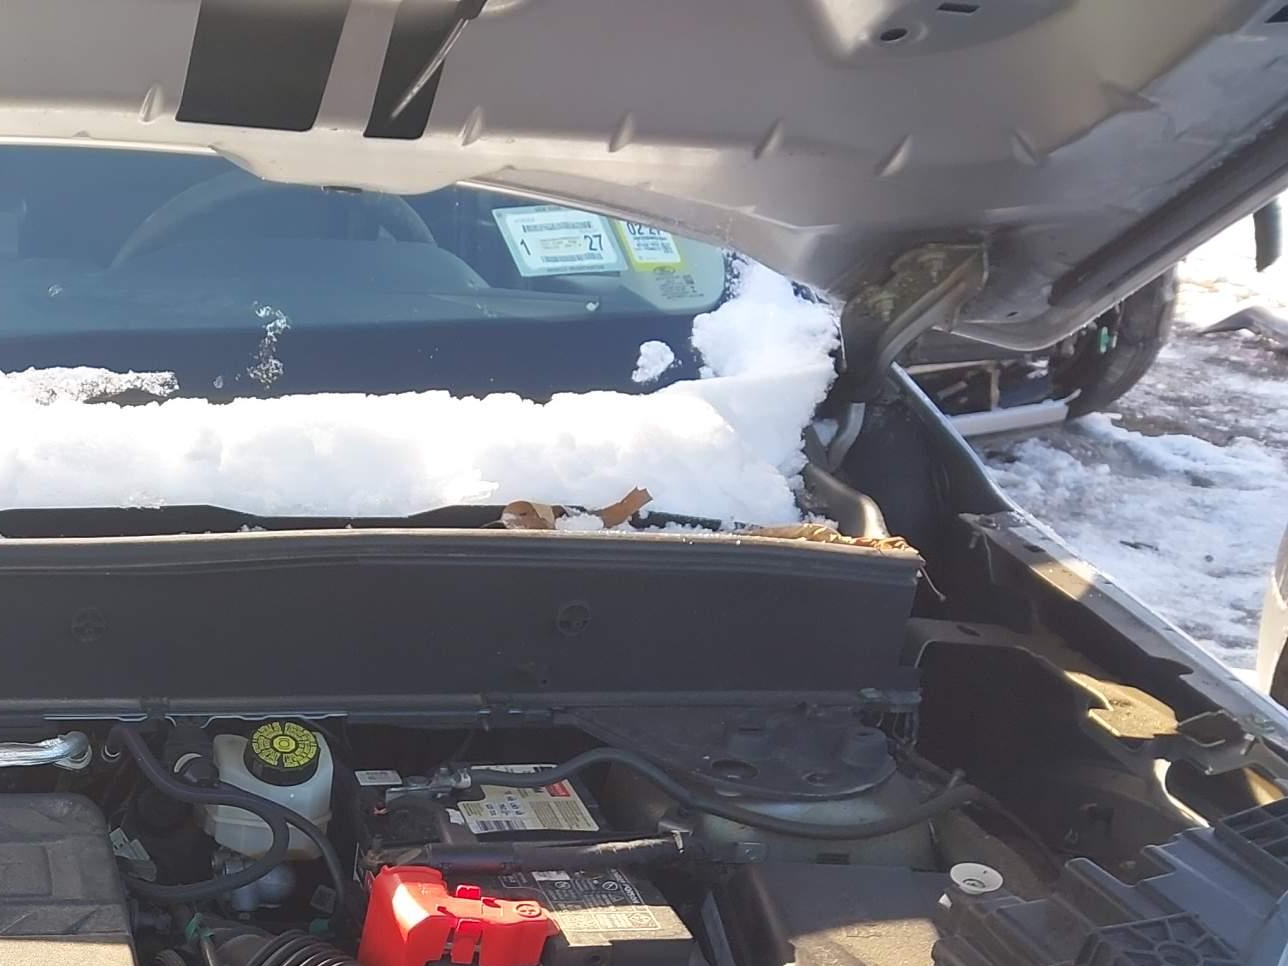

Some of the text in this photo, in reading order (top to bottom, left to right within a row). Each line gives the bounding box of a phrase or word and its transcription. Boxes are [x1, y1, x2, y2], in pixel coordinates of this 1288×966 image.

[626, 221, 644, 235] 02
[520, 238, 531, 256] 1
[583, 234, 604, 251] 27
